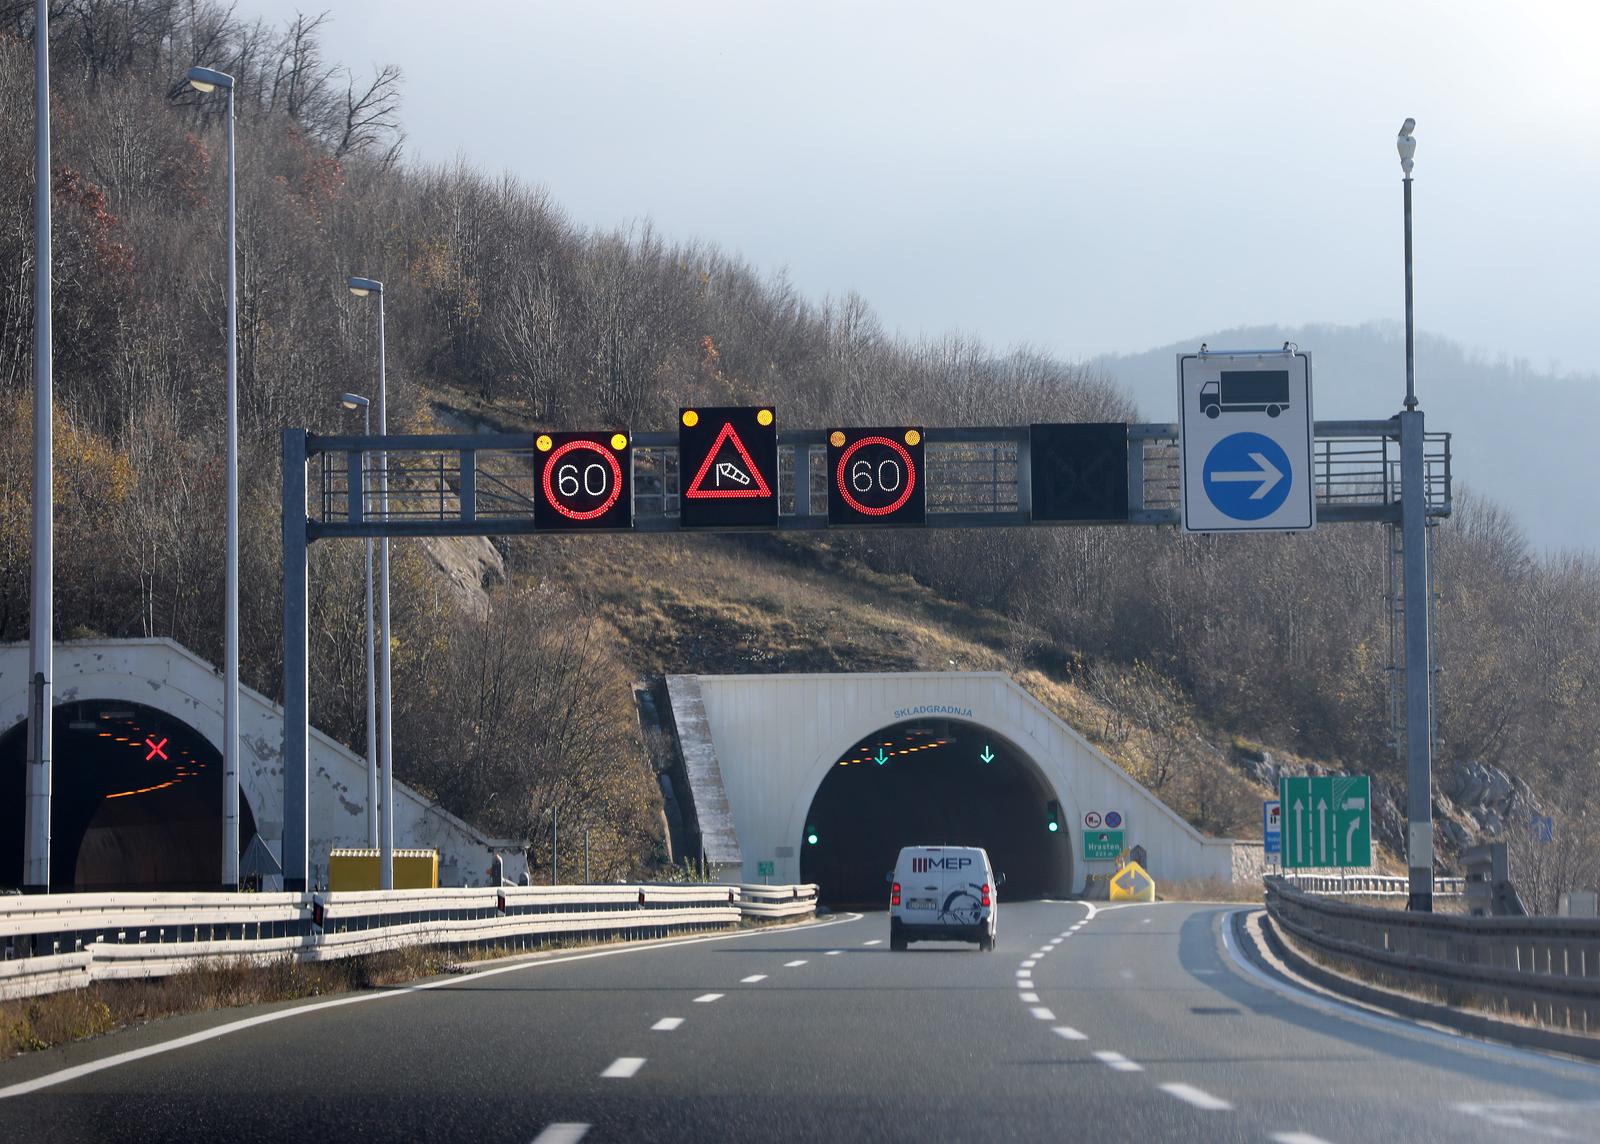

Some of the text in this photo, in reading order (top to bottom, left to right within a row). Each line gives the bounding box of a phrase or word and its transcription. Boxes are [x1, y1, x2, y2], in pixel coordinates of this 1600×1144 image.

[558, 463, 606, 496] 60
[852, 460, 900, 492] 60
[894, 705, 973, 719] SKLADGRADNJA
[928, 857, 971, 869] MEP
